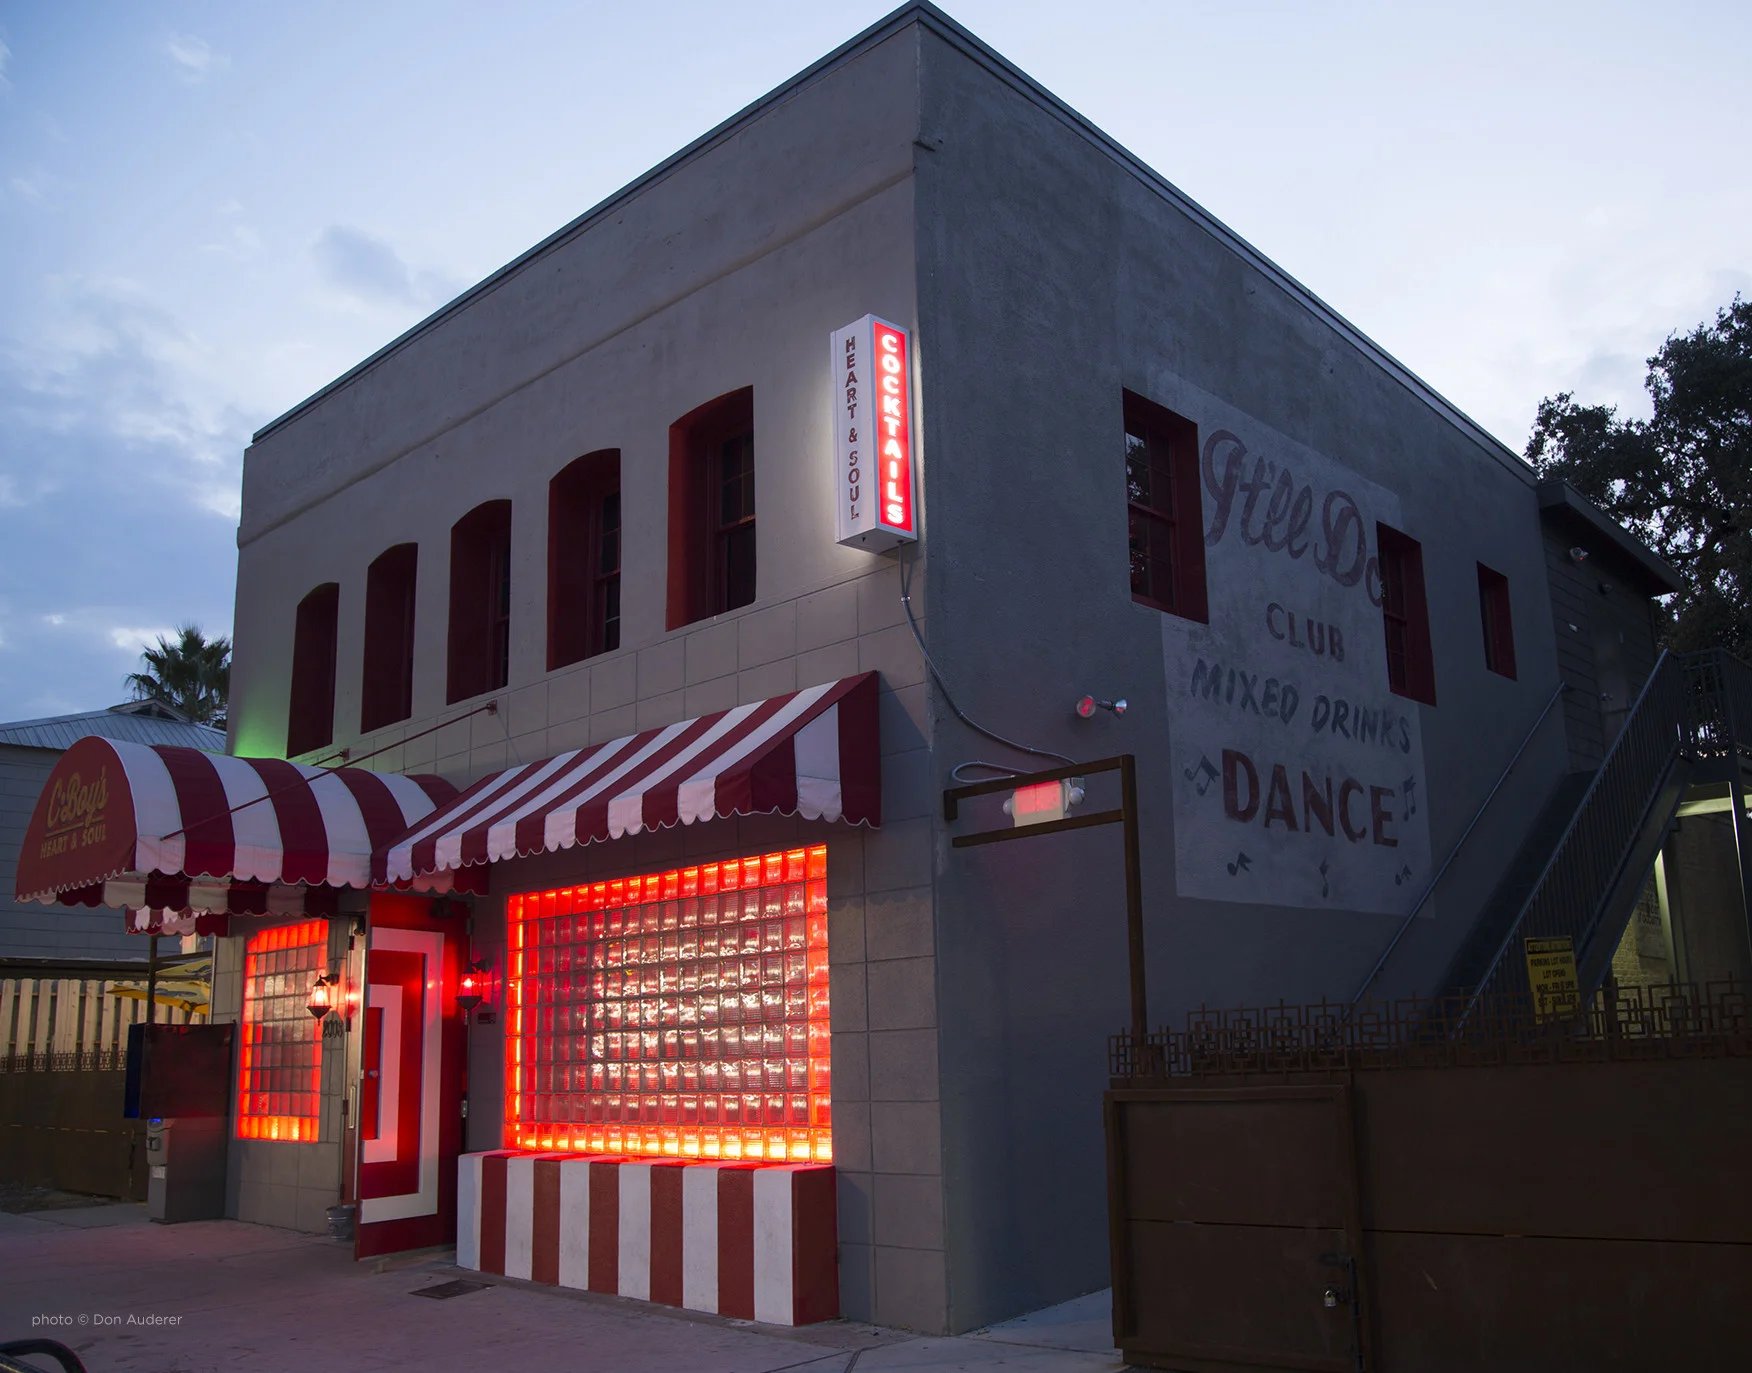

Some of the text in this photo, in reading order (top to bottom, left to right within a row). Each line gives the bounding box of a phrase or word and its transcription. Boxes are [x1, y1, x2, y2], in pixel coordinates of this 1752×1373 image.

[845, 336, 861, 521] HEART & SOUL
[881, 334, 905, 525] COCKTAILS
[1266, 602, 1345, 663] CLUB
[1190, 657, 1411, 754] MIXED DRINKS
[40, 836, 68, 860] HEART
[82, 823, 106, 847] SOUL
[1221, 748, 1399, 848] DANCE
